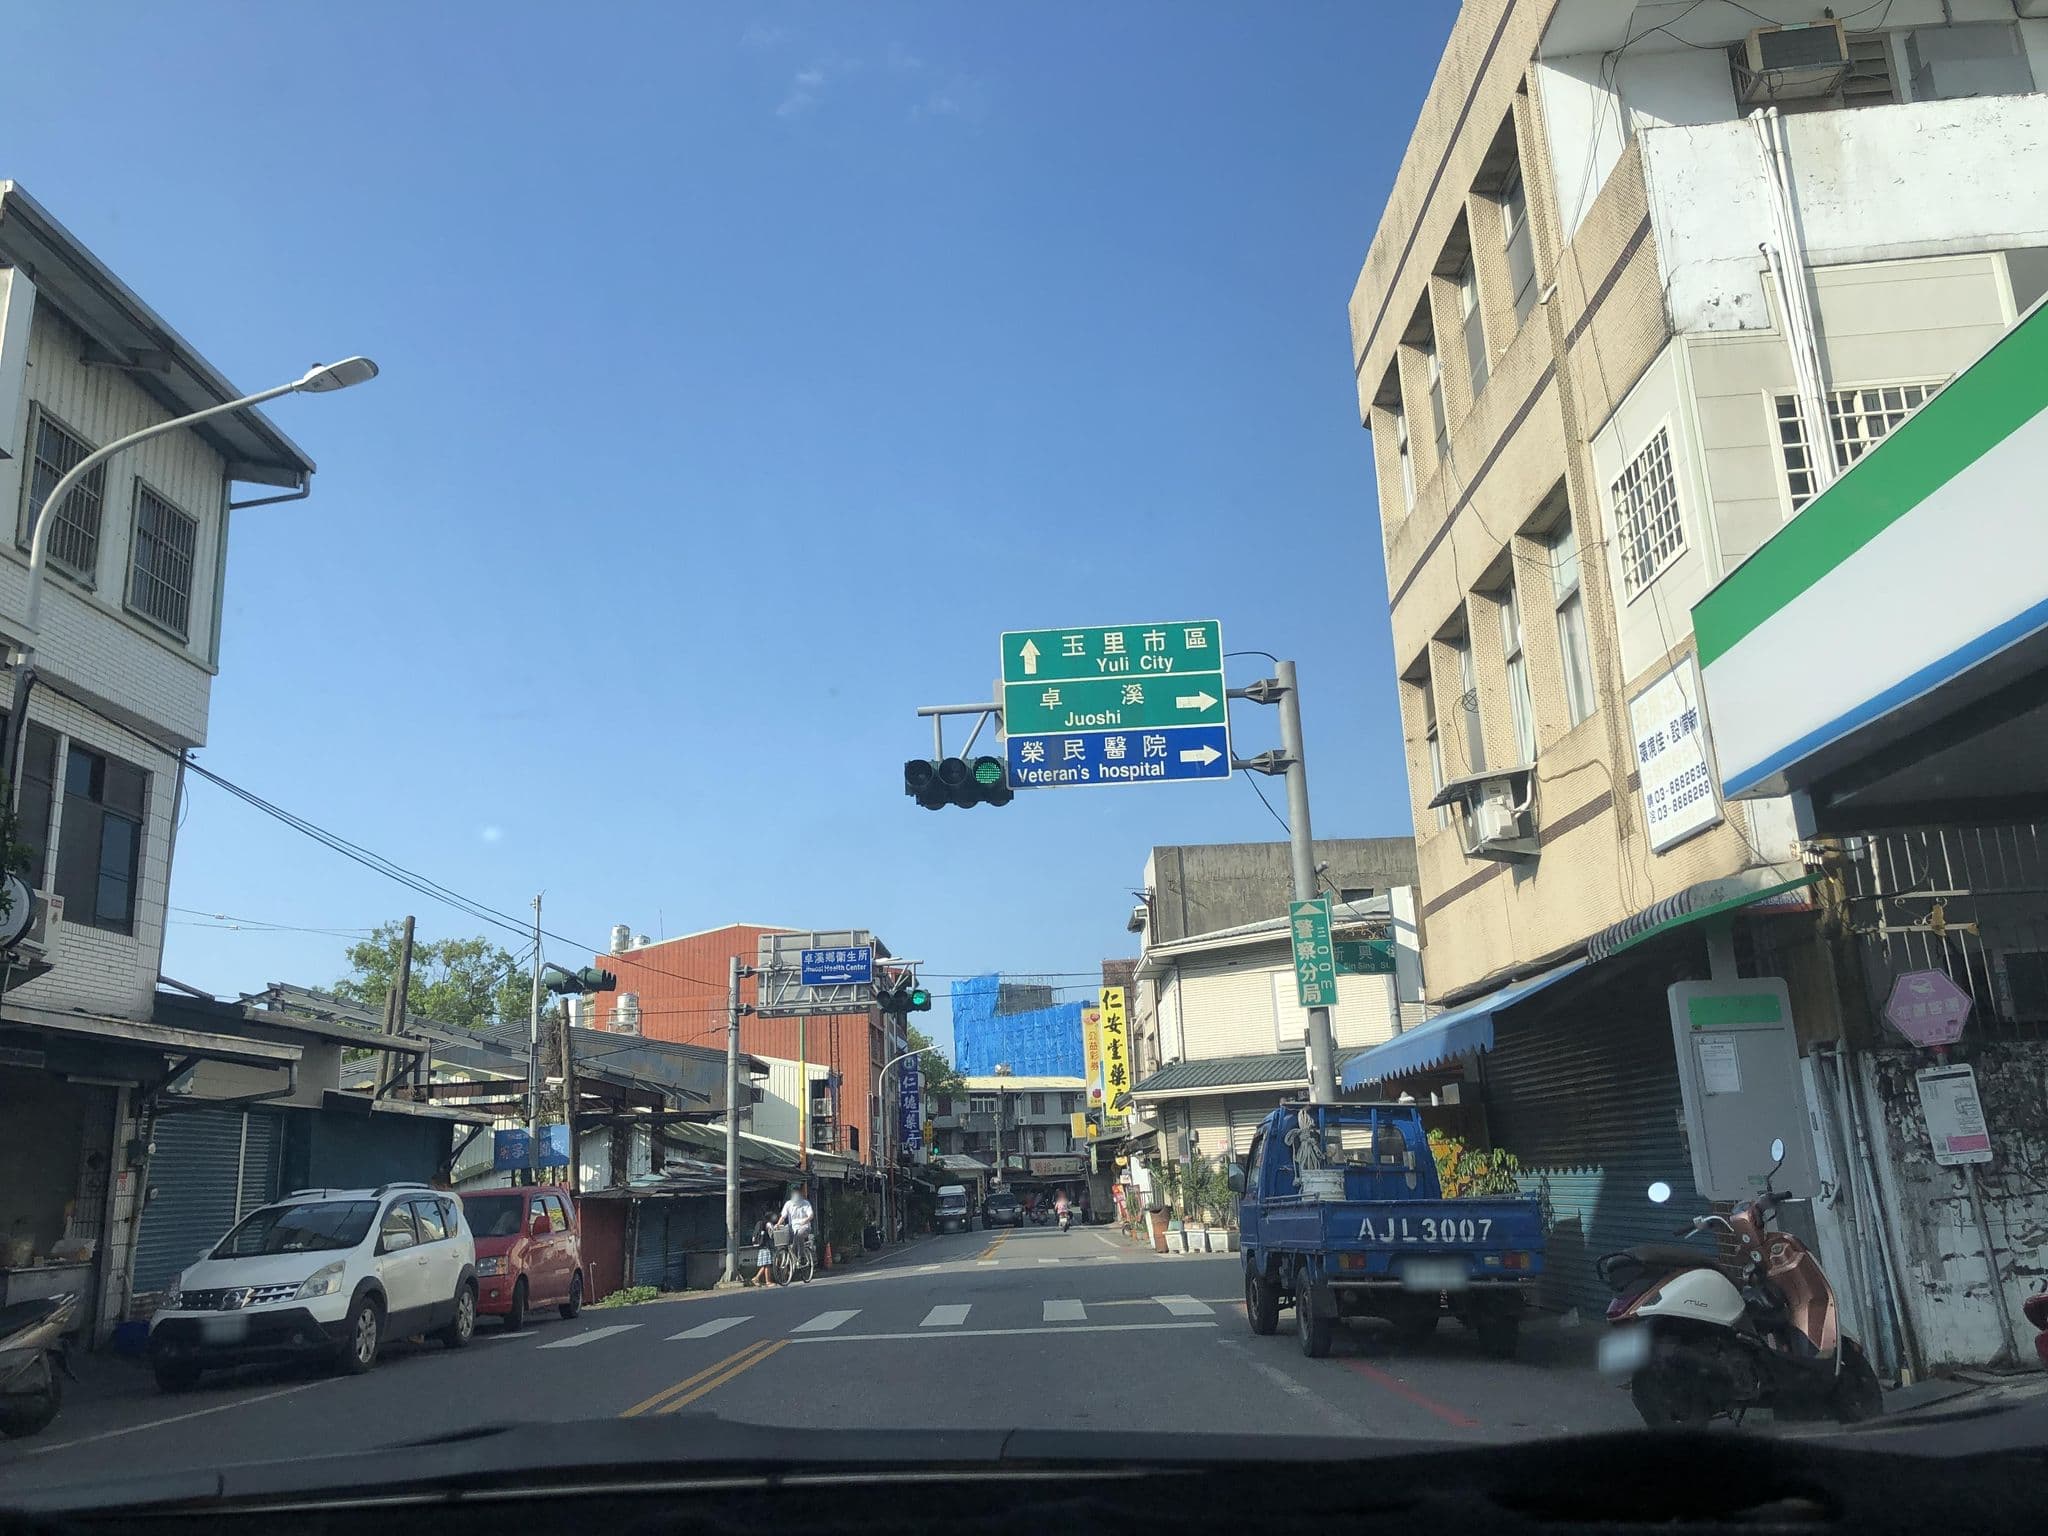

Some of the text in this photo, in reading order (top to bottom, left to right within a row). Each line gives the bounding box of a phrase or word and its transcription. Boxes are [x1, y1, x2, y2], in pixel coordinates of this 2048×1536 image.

[1061, 627, 1208, 658] 玉里市區
[1096, 654, 1174, 673] Yuli City
[1039, 683, 1146, 710] 卓溪
[1064, 708, 1122, 727] Juoshi
[1020, 734, 1168, 764] 榮民醫院
[1017, 760, 1165, 784] Veteran's hospital
[845, 963, 867, 971] Center
[1294, 918, 1322, 1004] 警察分局
[1357, 1217, 1493, 1243] AJL3007
